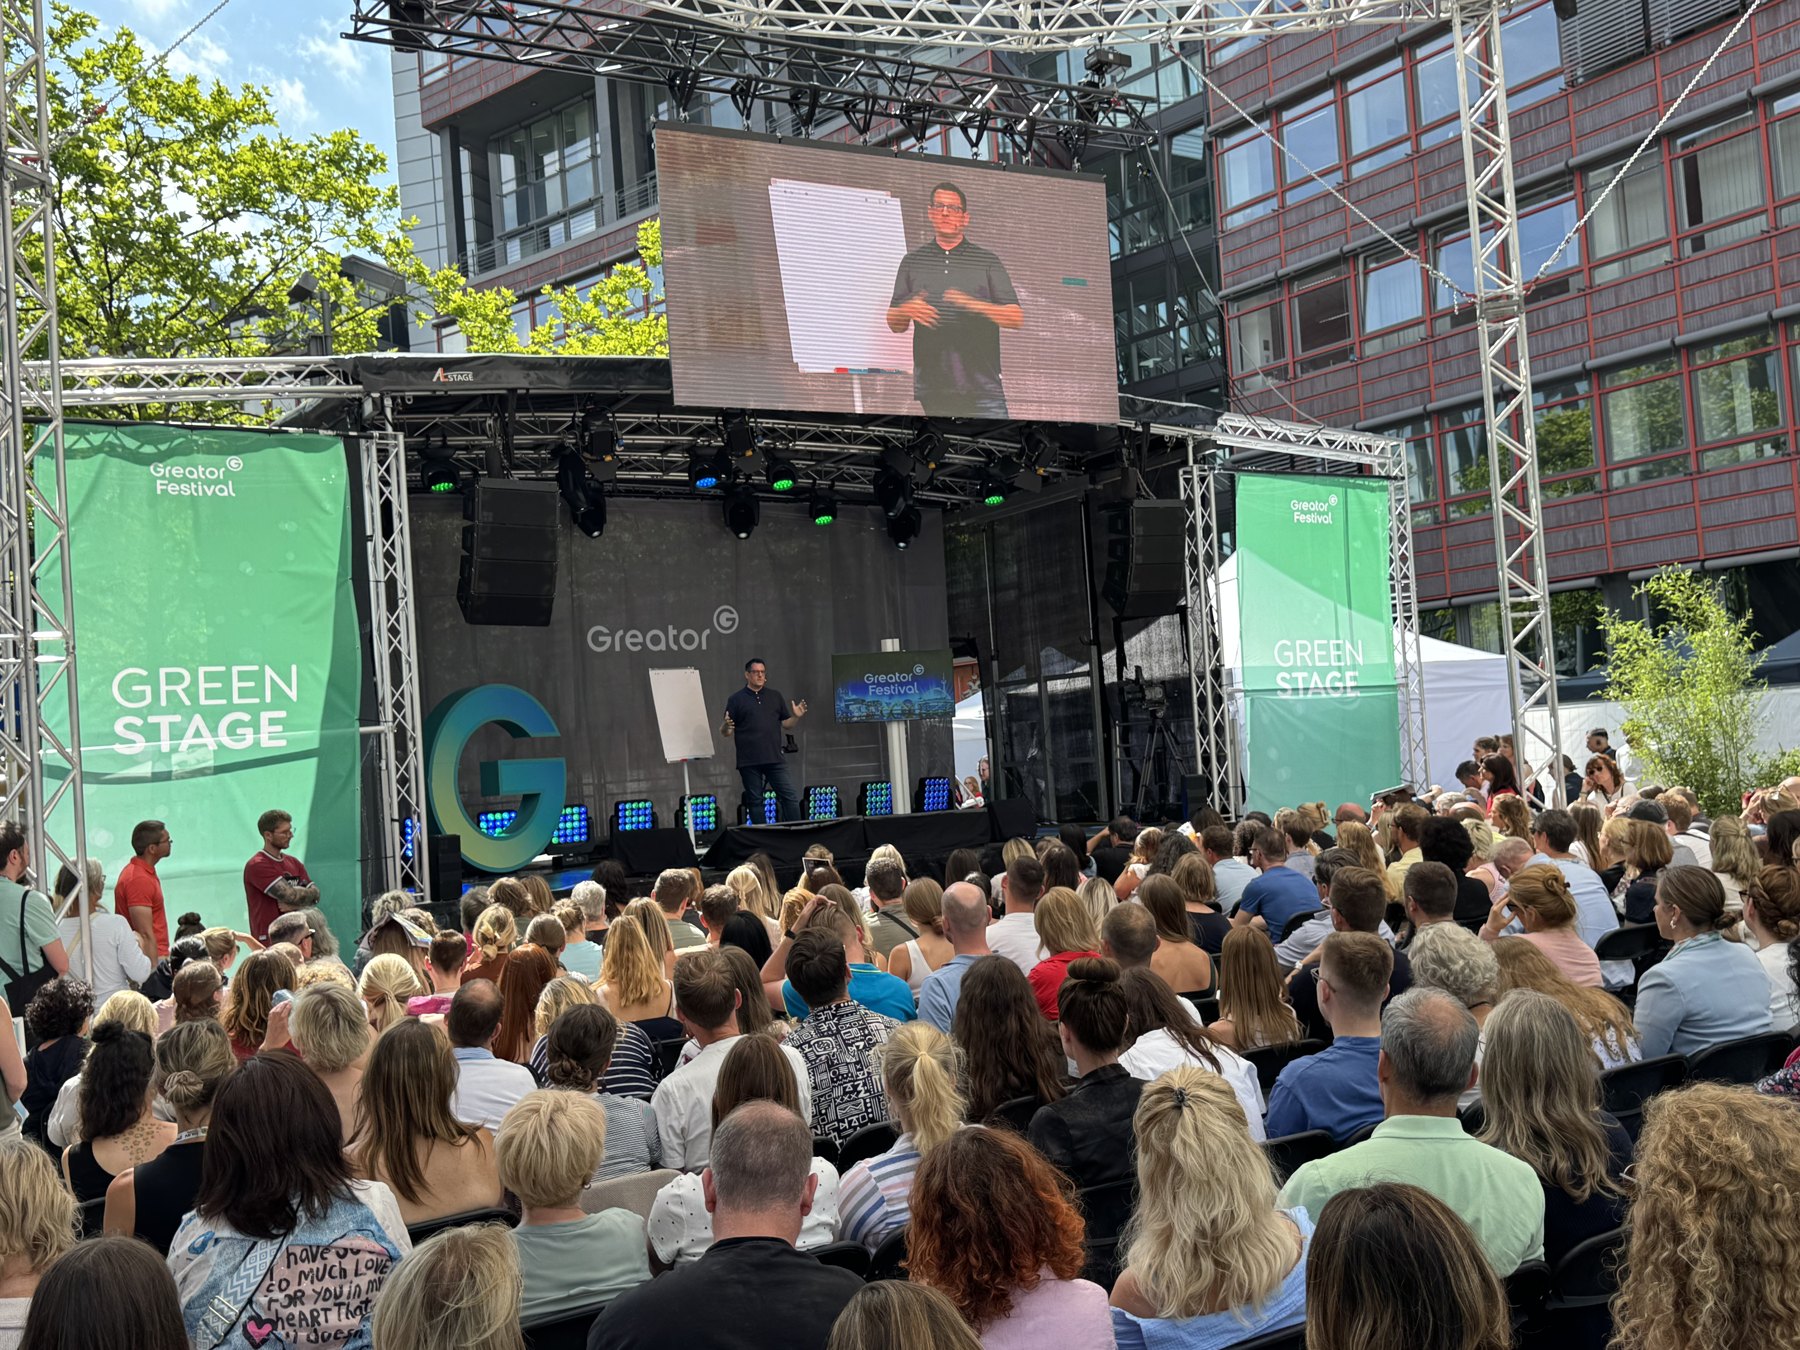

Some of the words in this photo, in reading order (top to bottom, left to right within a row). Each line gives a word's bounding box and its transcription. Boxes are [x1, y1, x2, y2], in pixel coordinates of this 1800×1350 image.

[448, 373, 473, 382] STAGE
[150, 462, 225, 480] Greator
[156, 479, 236, 497] Festival
[1290, 499, 1329, 512] Greator
[1293, 511, 1333, 525] Festival
[586, 624, 711, 653] Greator
[1274, 639, 1363, 667] GREEN
[111, 663, 298, 709] GREEN
[863, 671, 914, 684] Greator
[1275, 671, 1360, 699] STAGE
[868, 681, 920, 696] Festival
[112, 710, 288, 755] STAGE
